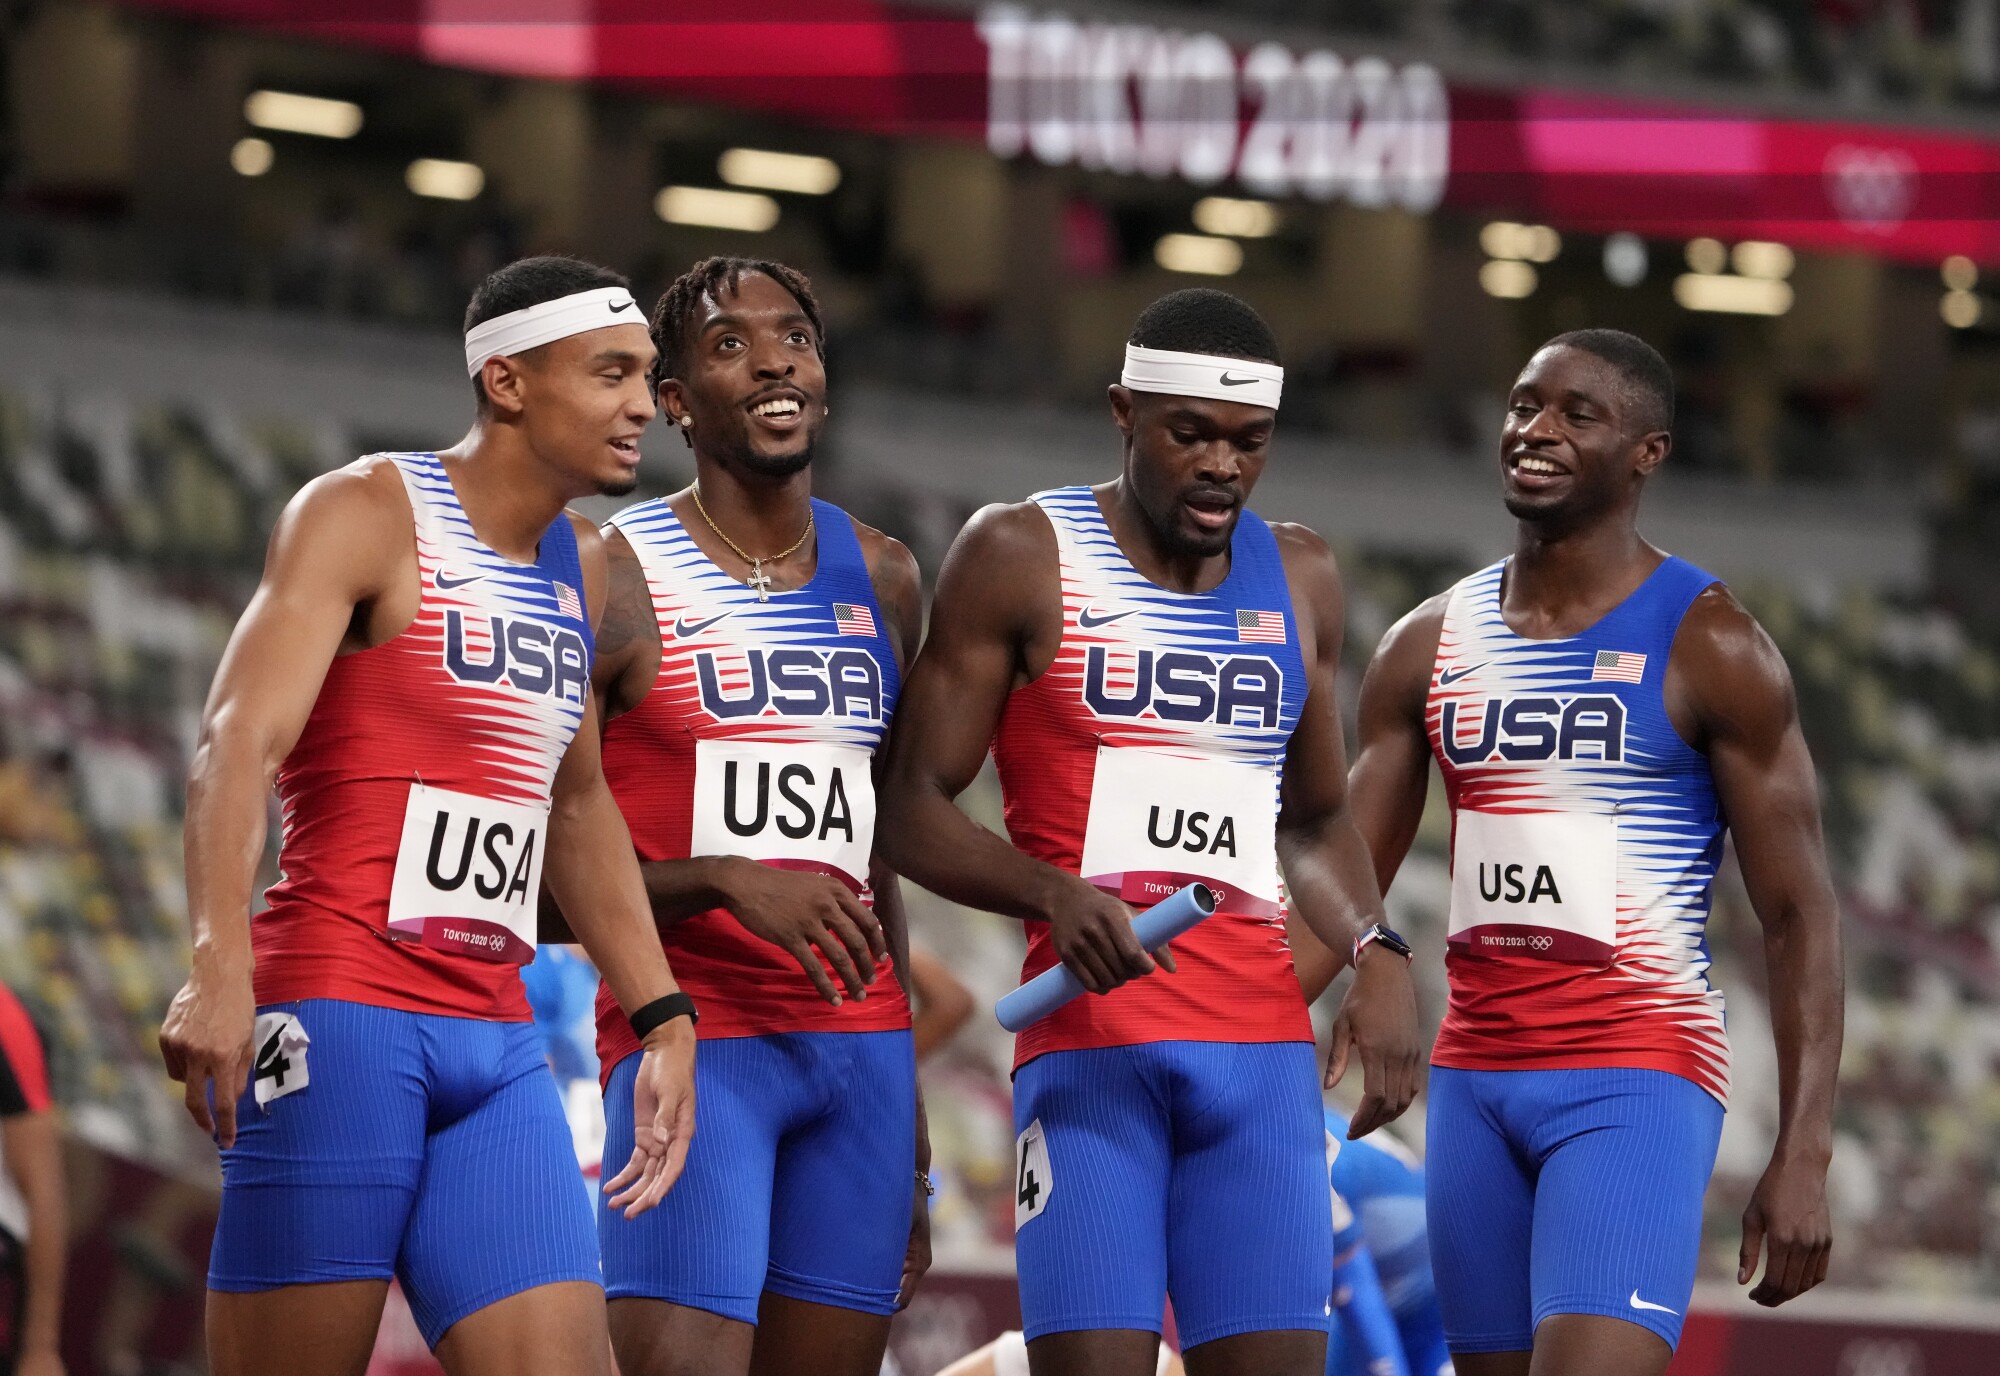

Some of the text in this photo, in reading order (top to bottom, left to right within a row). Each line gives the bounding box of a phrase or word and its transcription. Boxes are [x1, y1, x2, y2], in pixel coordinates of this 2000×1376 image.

[978, 8, 1451, 214] TOKYO 2020
[442, 604, 590, 708] USA
[692, 648, 883, 724] USA
[1081, 641, 1284, 730] USA
[1439, 693, 1628, 769] USA
[724, 760, 853, 843] USA
[1147, 805, 1237, 858] USA
[425, 810, 536, 906] USA
[1144, 882, 1174, 895] TOKYO
[1479, 862, 1563, 904] USA
[443, 928, 488, 946] TOKYO 2020
[1481, 935, 1526, 946] TOKYO 2020
[254, 1023, 291, 1088] 4
[1018, 1138, 1040, 1212] 4
